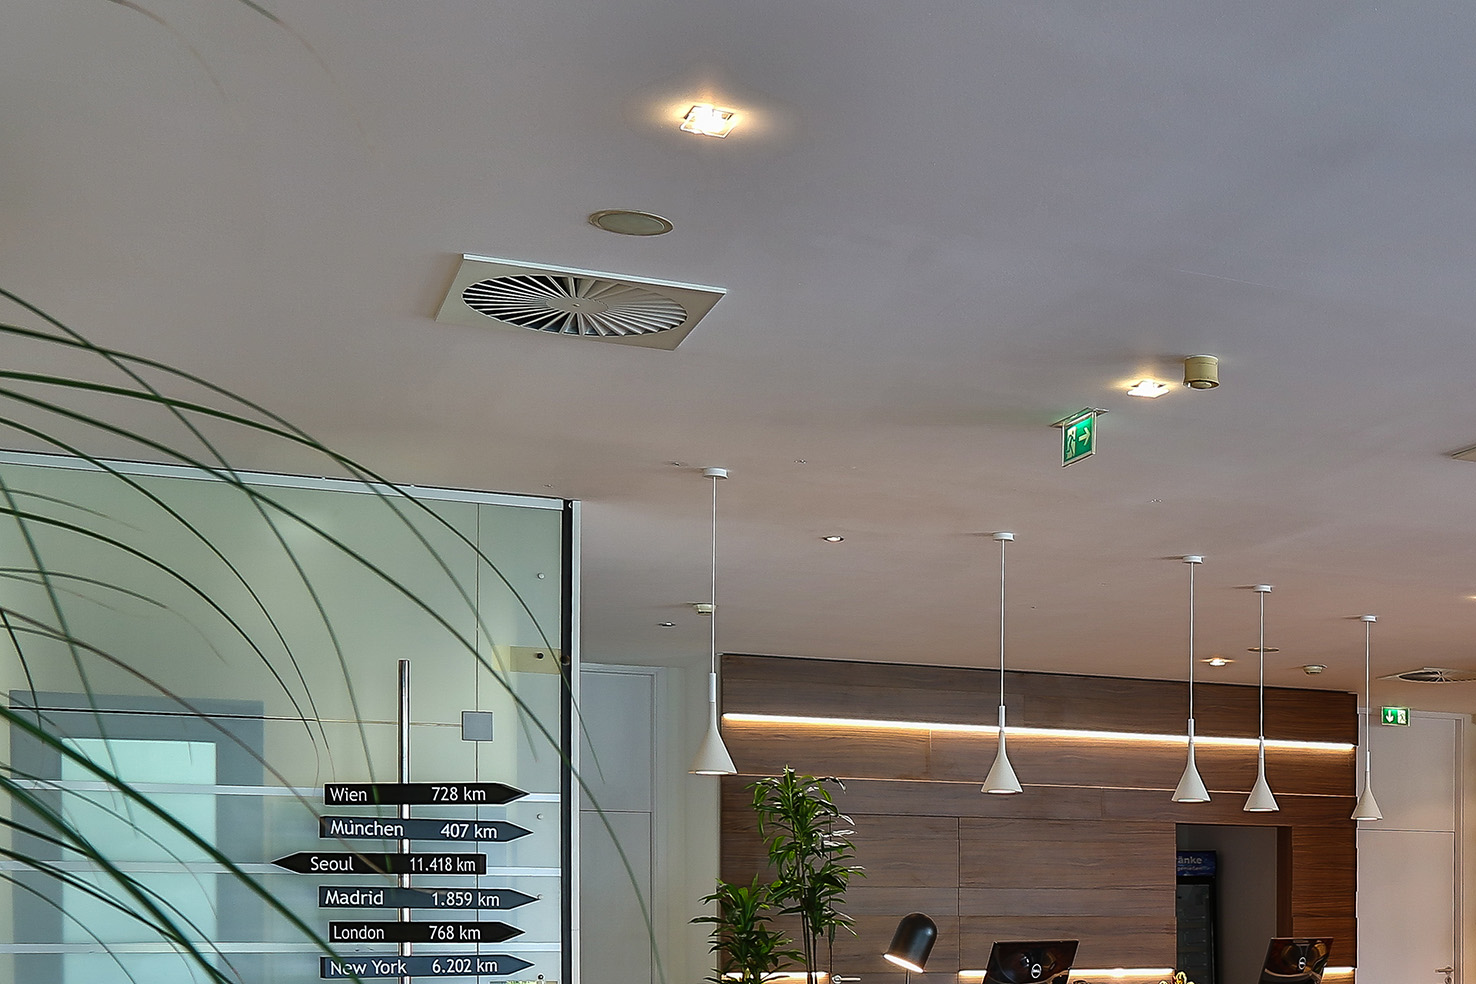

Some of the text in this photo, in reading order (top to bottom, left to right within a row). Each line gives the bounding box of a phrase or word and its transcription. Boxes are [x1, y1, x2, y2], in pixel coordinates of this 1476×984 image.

[330, 786, 486, 802] Wien 728 km
[330, 819, 497, 839] München 407 km
[310, 856, 476, 872] Seoul 11.418 km
[325, 890, 500, 907] Madrid 1.859 km
[333, 925, 481, 940] London 768 km
[330, 958, 498, 975] New York 6.202 km
